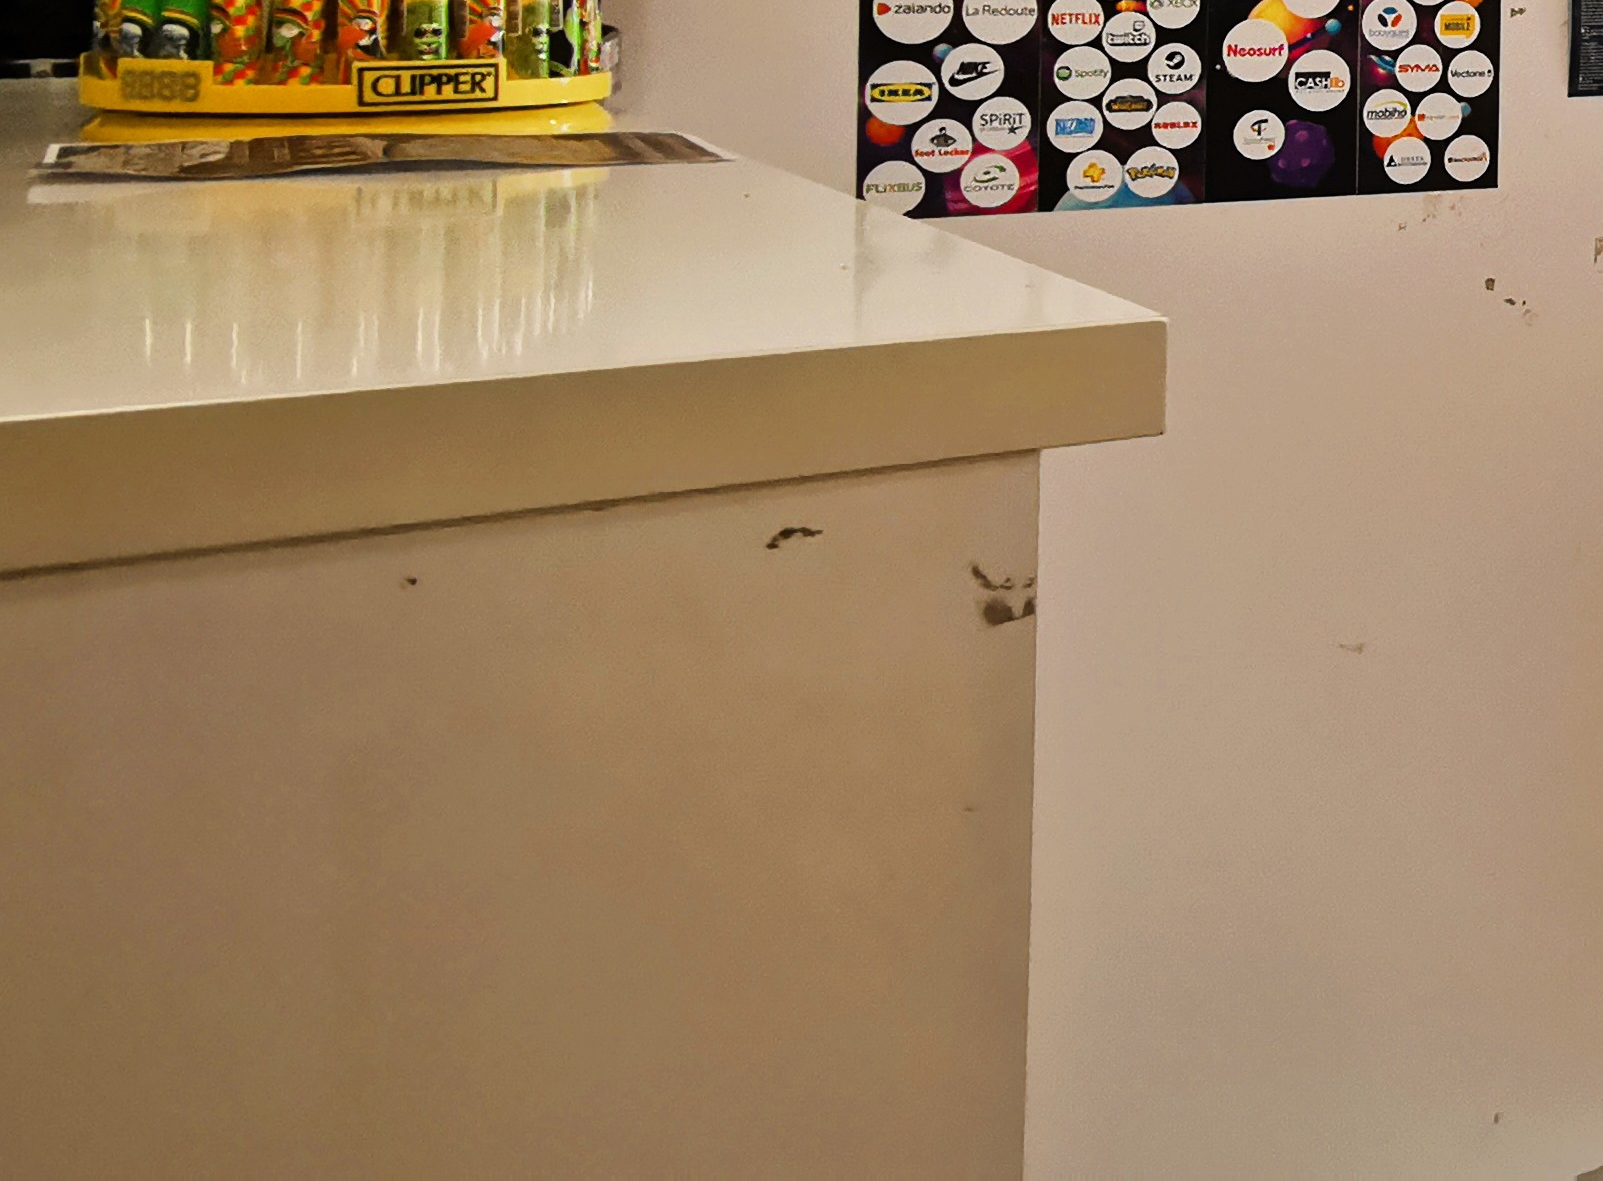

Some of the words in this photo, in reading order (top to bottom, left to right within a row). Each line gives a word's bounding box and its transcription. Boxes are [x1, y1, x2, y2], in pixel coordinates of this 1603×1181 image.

[894, 3, 951, 15] zalando
[965, 5, 979, 16] La
[982, 5, 1035, 17] Redoute
[1051, 13, 1100, 26] NETFLIX
[1106, 32, 1150, 46] twitch
[1227, 44, 1285, 57] Neosurf
[1398, 64, 1440, 72] SYMA
[1450, 69, 1485, 78] Vectone
[1075, 69, 1109, 80] Spotify
[1155, 74, 1193, 83] STEAM
[371, 71, 485, 97] CLIPPER
[879, 88, 926, 97] IKEA
[1126, 164, 1177, 181] Pokémon
[866, 181, 923, 195] FLIXBUS
[963, 183, 1017, 192] COYOTE
